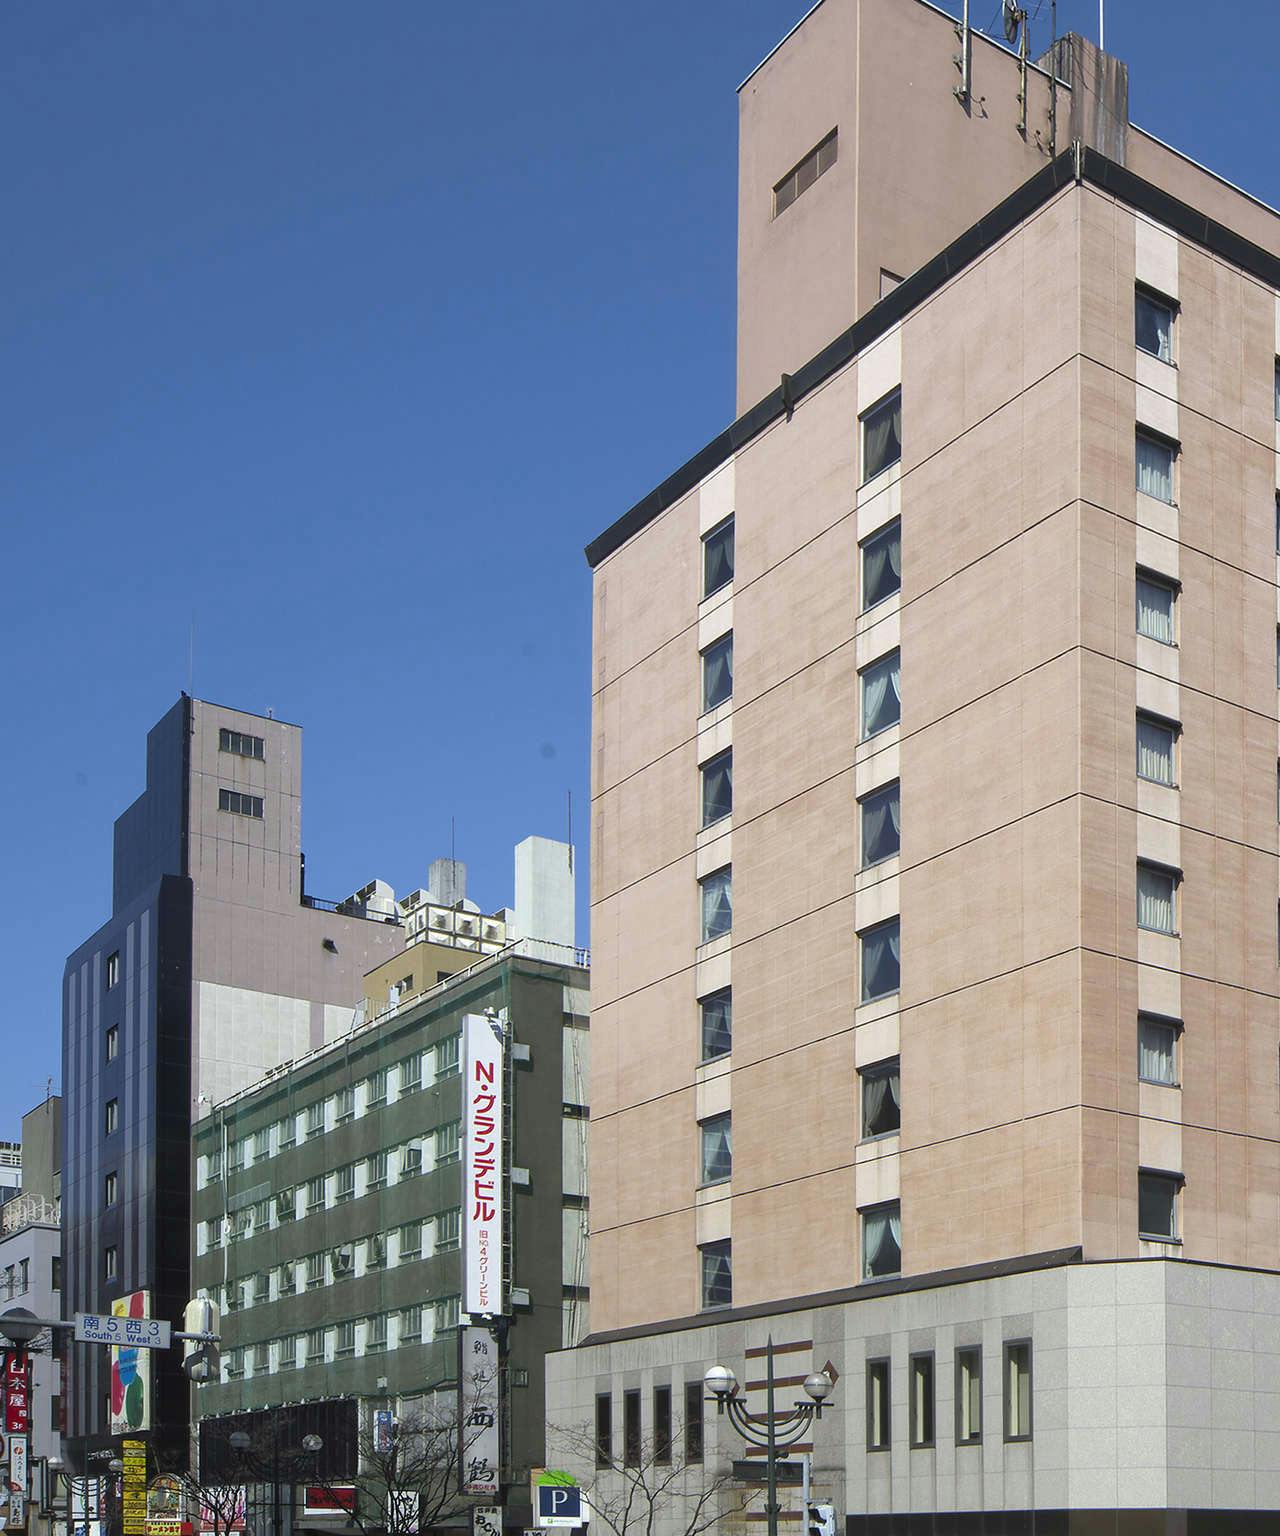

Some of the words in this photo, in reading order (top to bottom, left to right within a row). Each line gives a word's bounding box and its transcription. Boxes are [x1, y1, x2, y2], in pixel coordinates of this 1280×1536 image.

[84, 1316, 160, 1336] 南5西3
[84, 1330, 113, 1341] South
[114, 1333, 122, 1341] 5
[126, 1335, 151, 1344] West
[154, 1337, 161, 1345] 3
[551, 1490, 569, 1514] P
